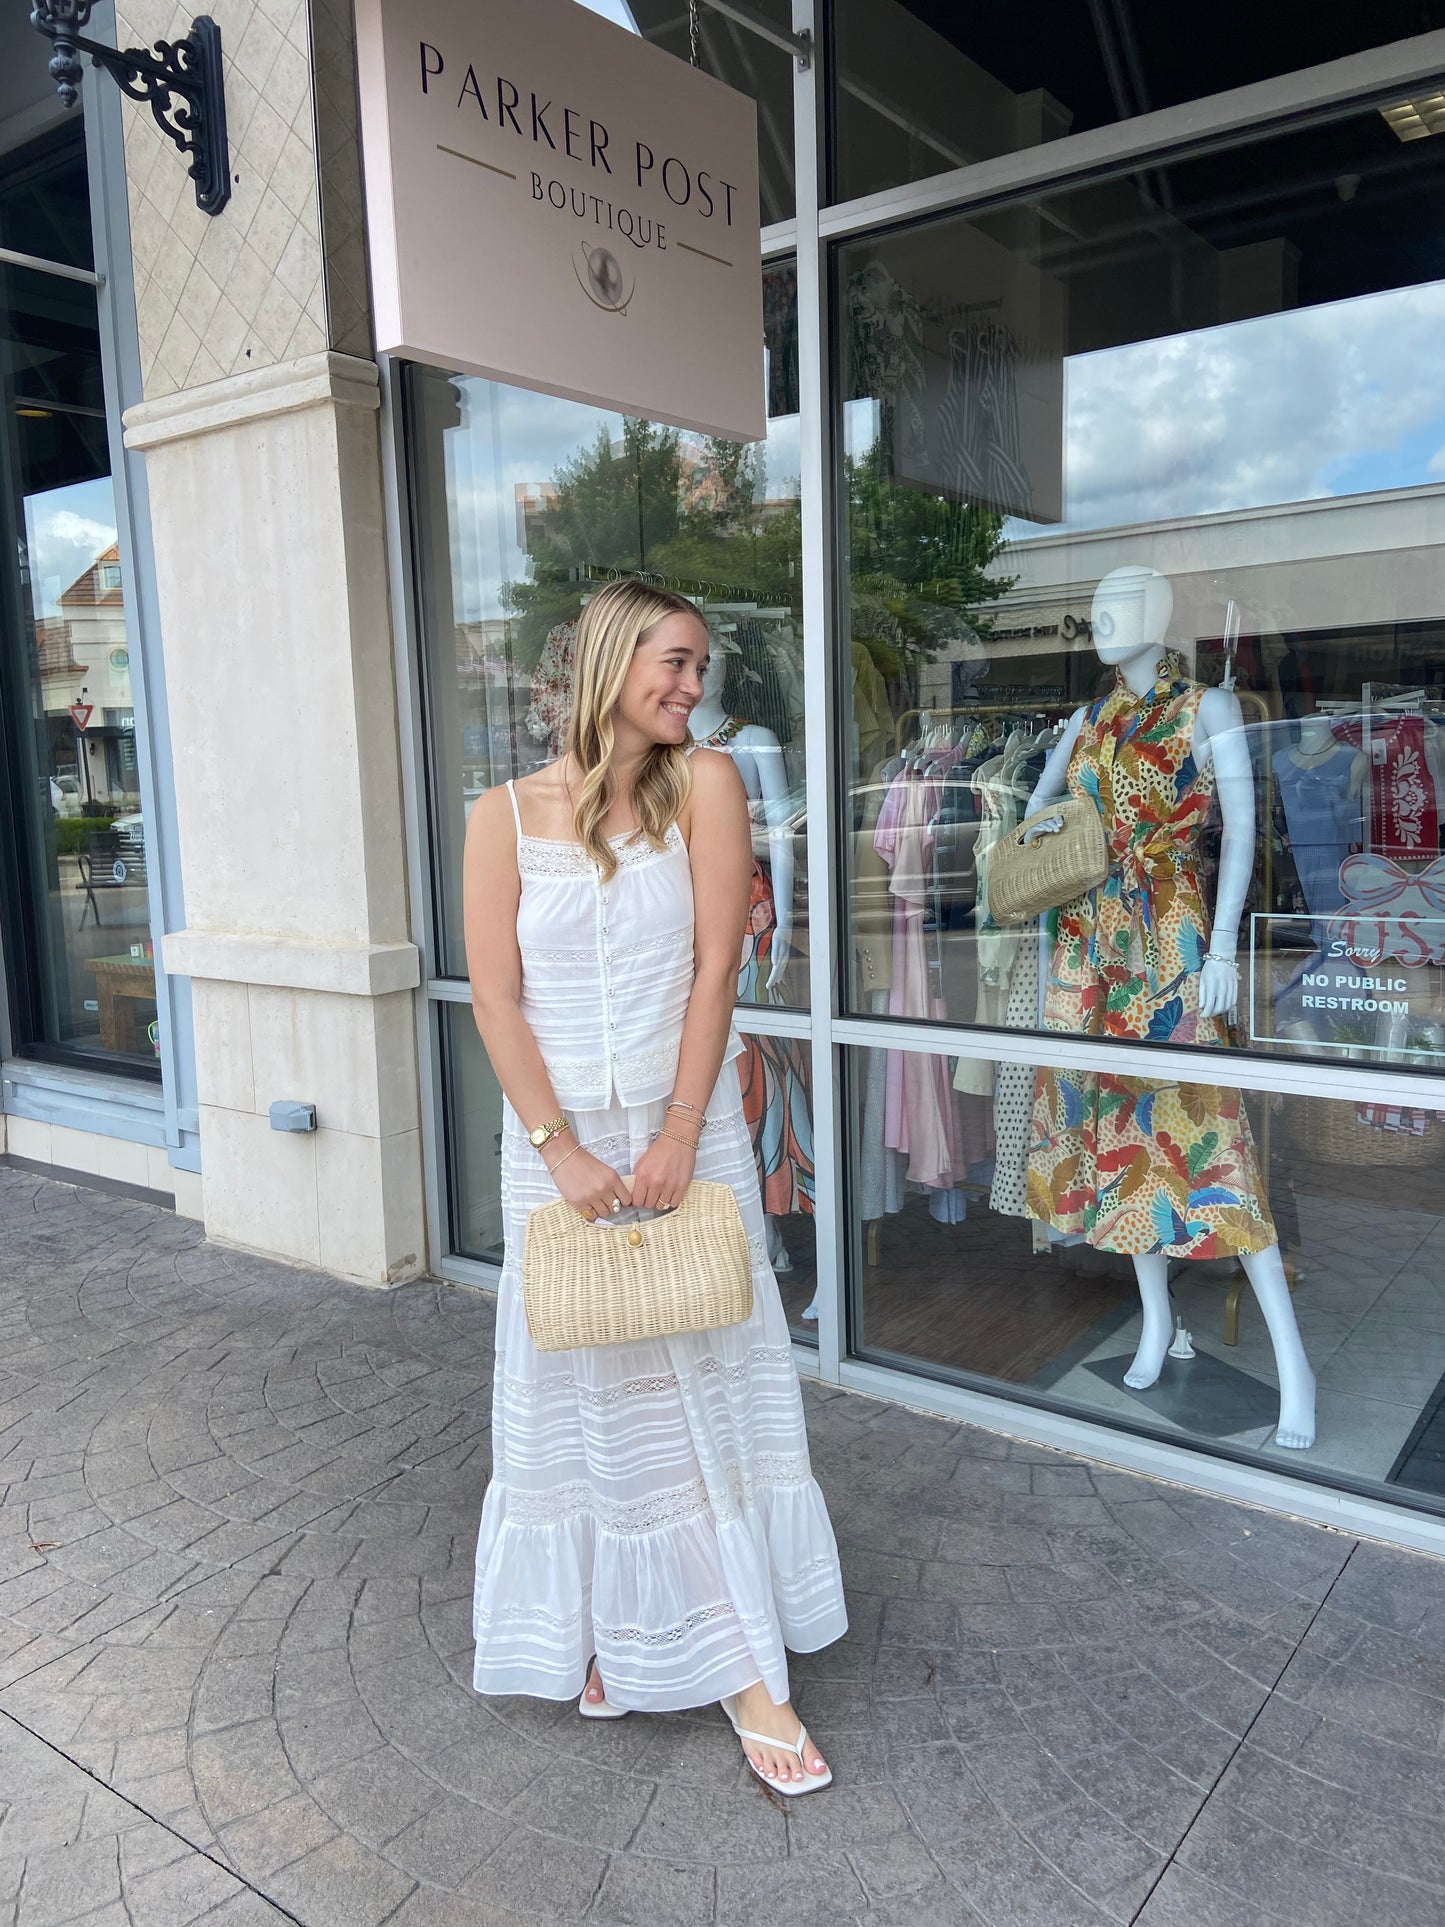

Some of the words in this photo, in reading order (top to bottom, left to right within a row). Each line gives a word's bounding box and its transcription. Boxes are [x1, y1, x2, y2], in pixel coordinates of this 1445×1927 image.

[419, 41, 613, 174] PARKER
[635, 141, 738, 226] POST
[530, 171, 668, 251] BOUTIQUE
[1327, 940, 1381, 962] Sorry
[1340, 910, 1445, 967] US
[1302, 973, 1329, 987] NO
[1335, 975, 1407, 992] PUBLIC
[1302, 995, 1409, 1015] RESTROOM
